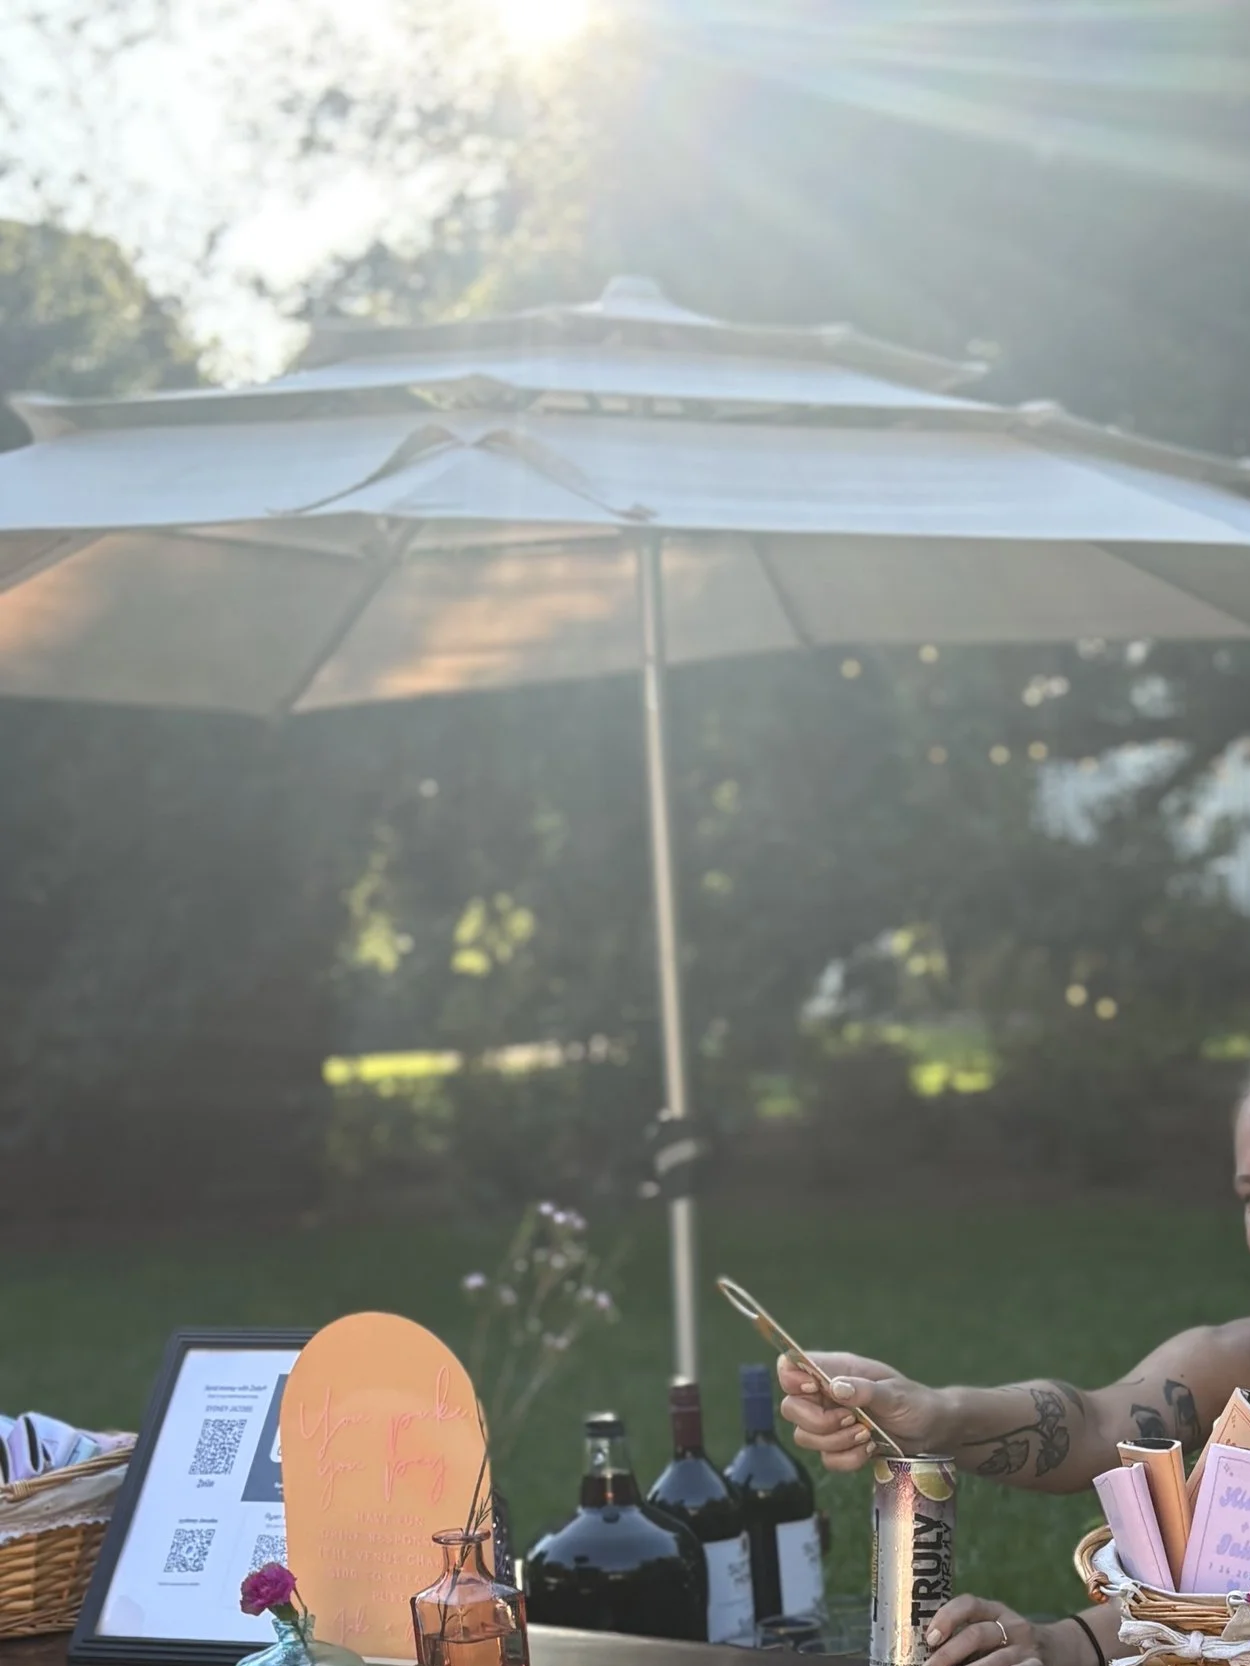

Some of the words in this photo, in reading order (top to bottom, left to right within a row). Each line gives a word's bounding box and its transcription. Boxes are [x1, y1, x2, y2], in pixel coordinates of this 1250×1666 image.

[300, 1385, 372, 1462] You
[317, 1459, 368, 1513] you
[384, 1453, 447, 1509] pay
[911, 1512, 943, 1627] TRULY
